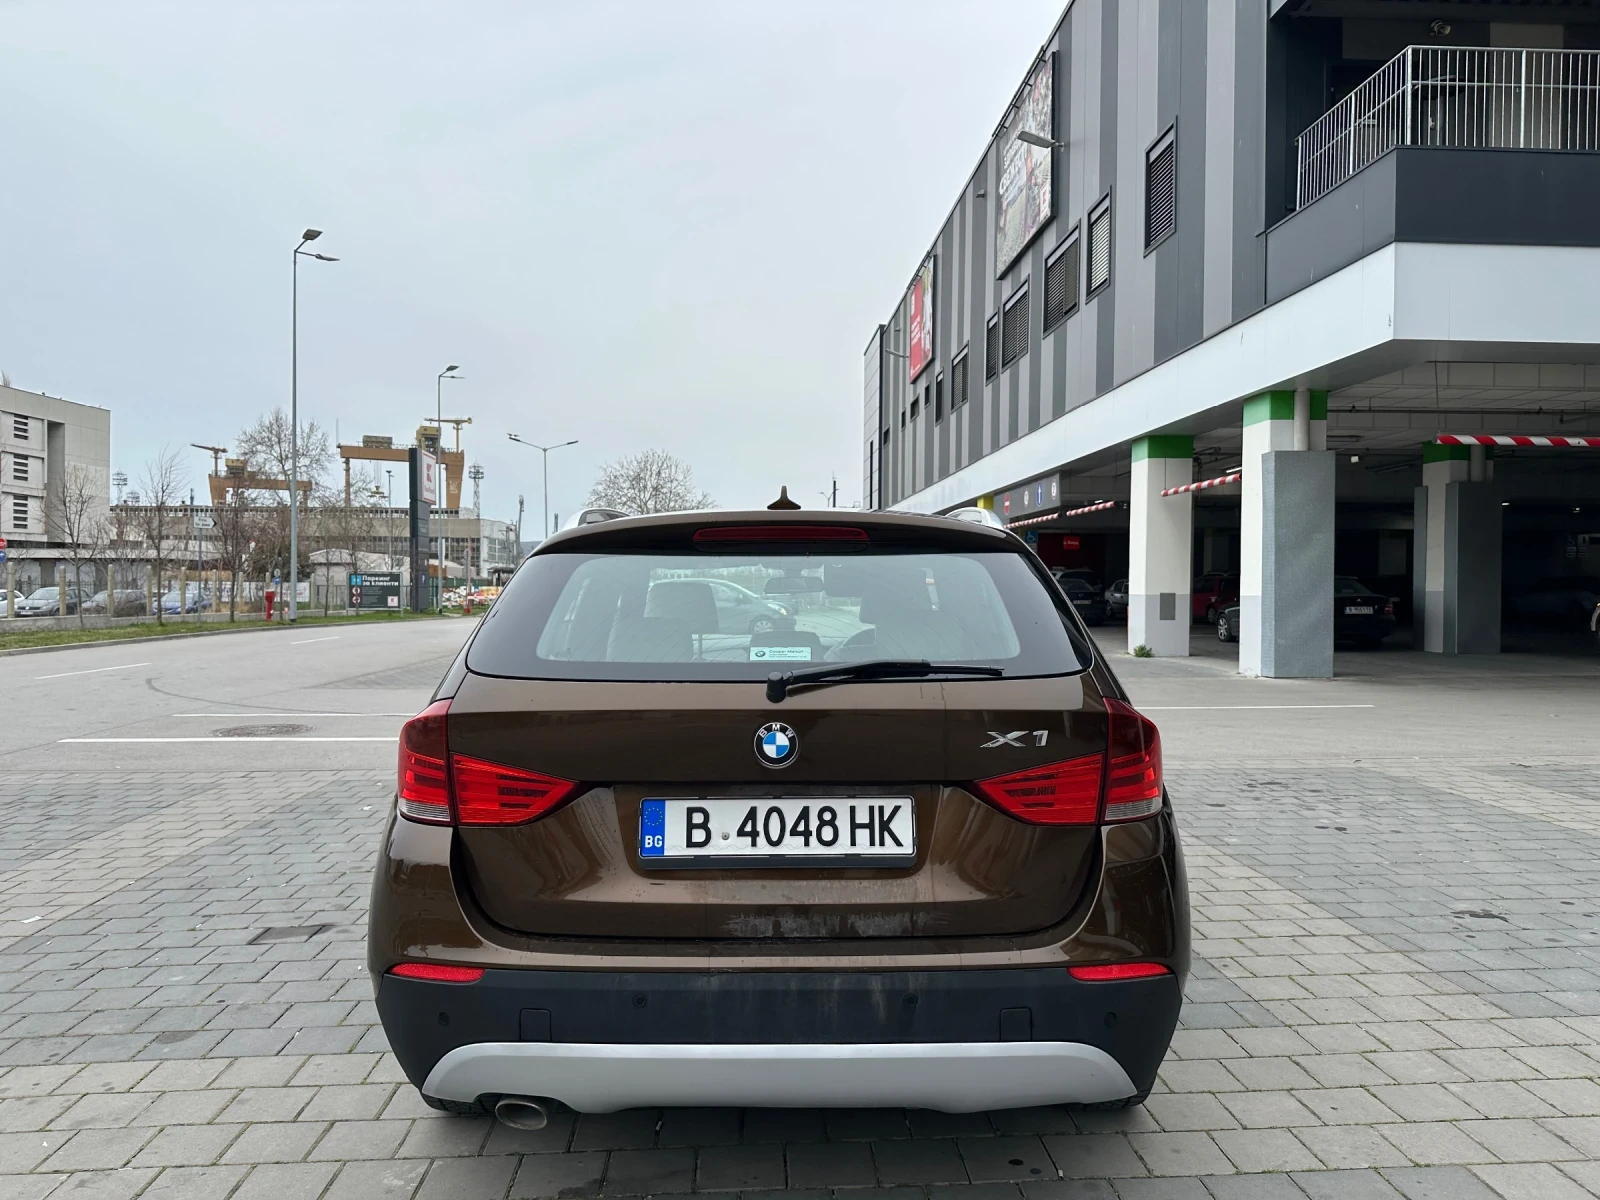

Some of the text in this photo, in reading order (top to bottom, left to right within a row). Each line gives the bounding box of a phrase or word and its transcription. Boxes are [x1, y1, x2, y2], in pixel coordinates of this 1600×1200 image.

[758, 722, 794, 739] BMW
[980, 730, 1048, 747] X1
[645, 805, 904, 848] BG B 4048 HK
